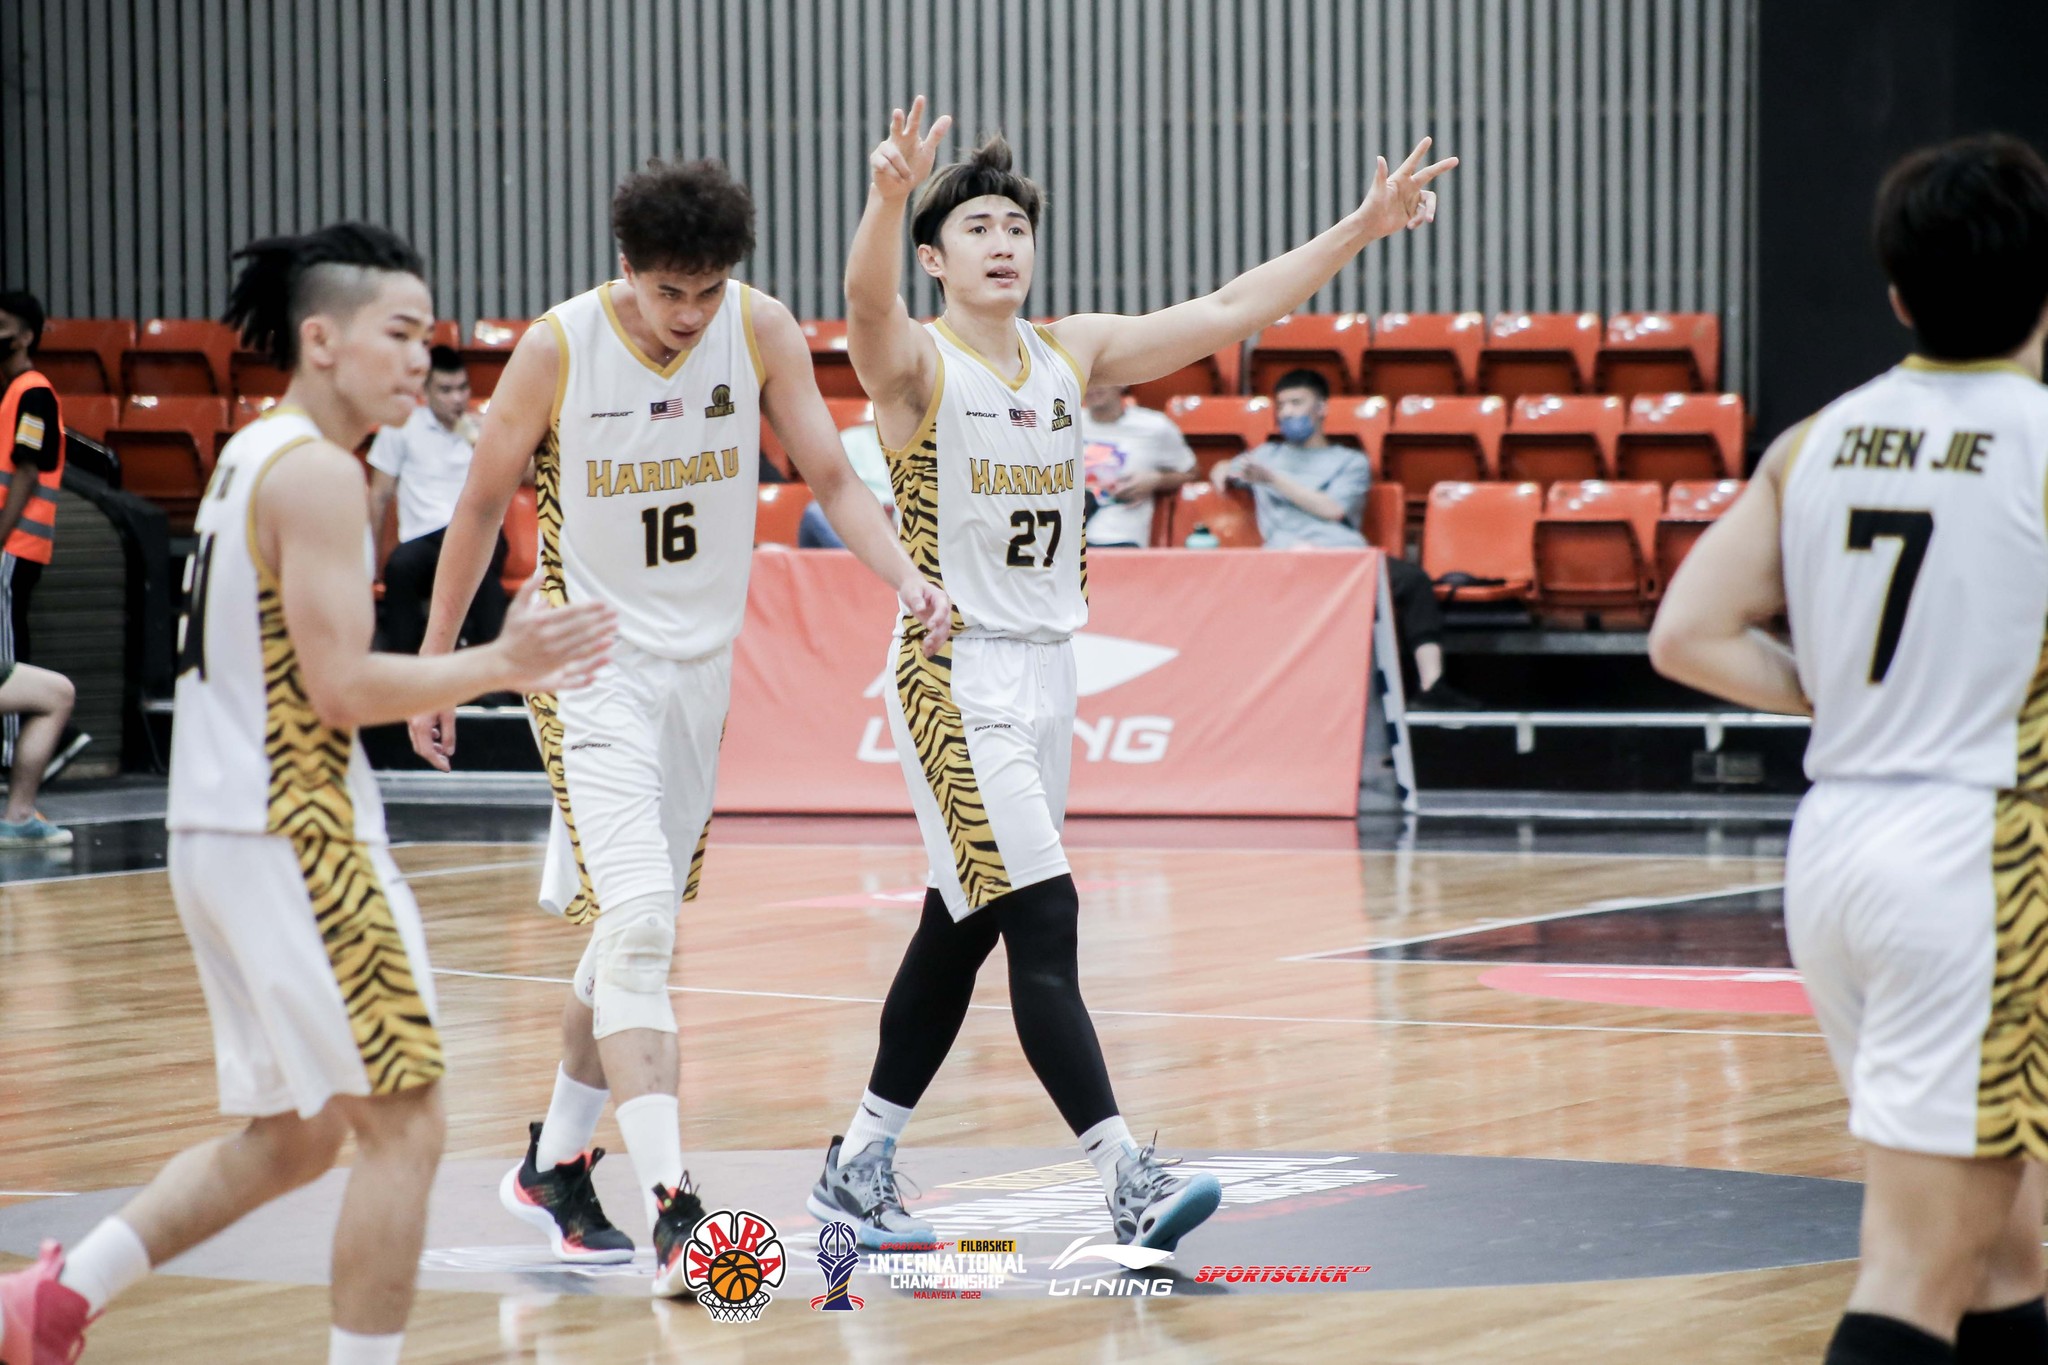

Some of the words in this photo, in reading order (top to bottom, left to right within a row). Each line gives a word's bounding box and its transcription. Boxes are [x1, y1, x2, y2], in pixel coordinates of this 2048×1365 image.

[586, 446, 739, 497] HARIMAU
[969, 458, 1074, 495] HARIMAU
[1931, 431, 1994, 473] JIE
[641, 501, 697, 568] 16
[1006, 510, 1062, 568] 27
[1845, 507, 1935, 685] 7
